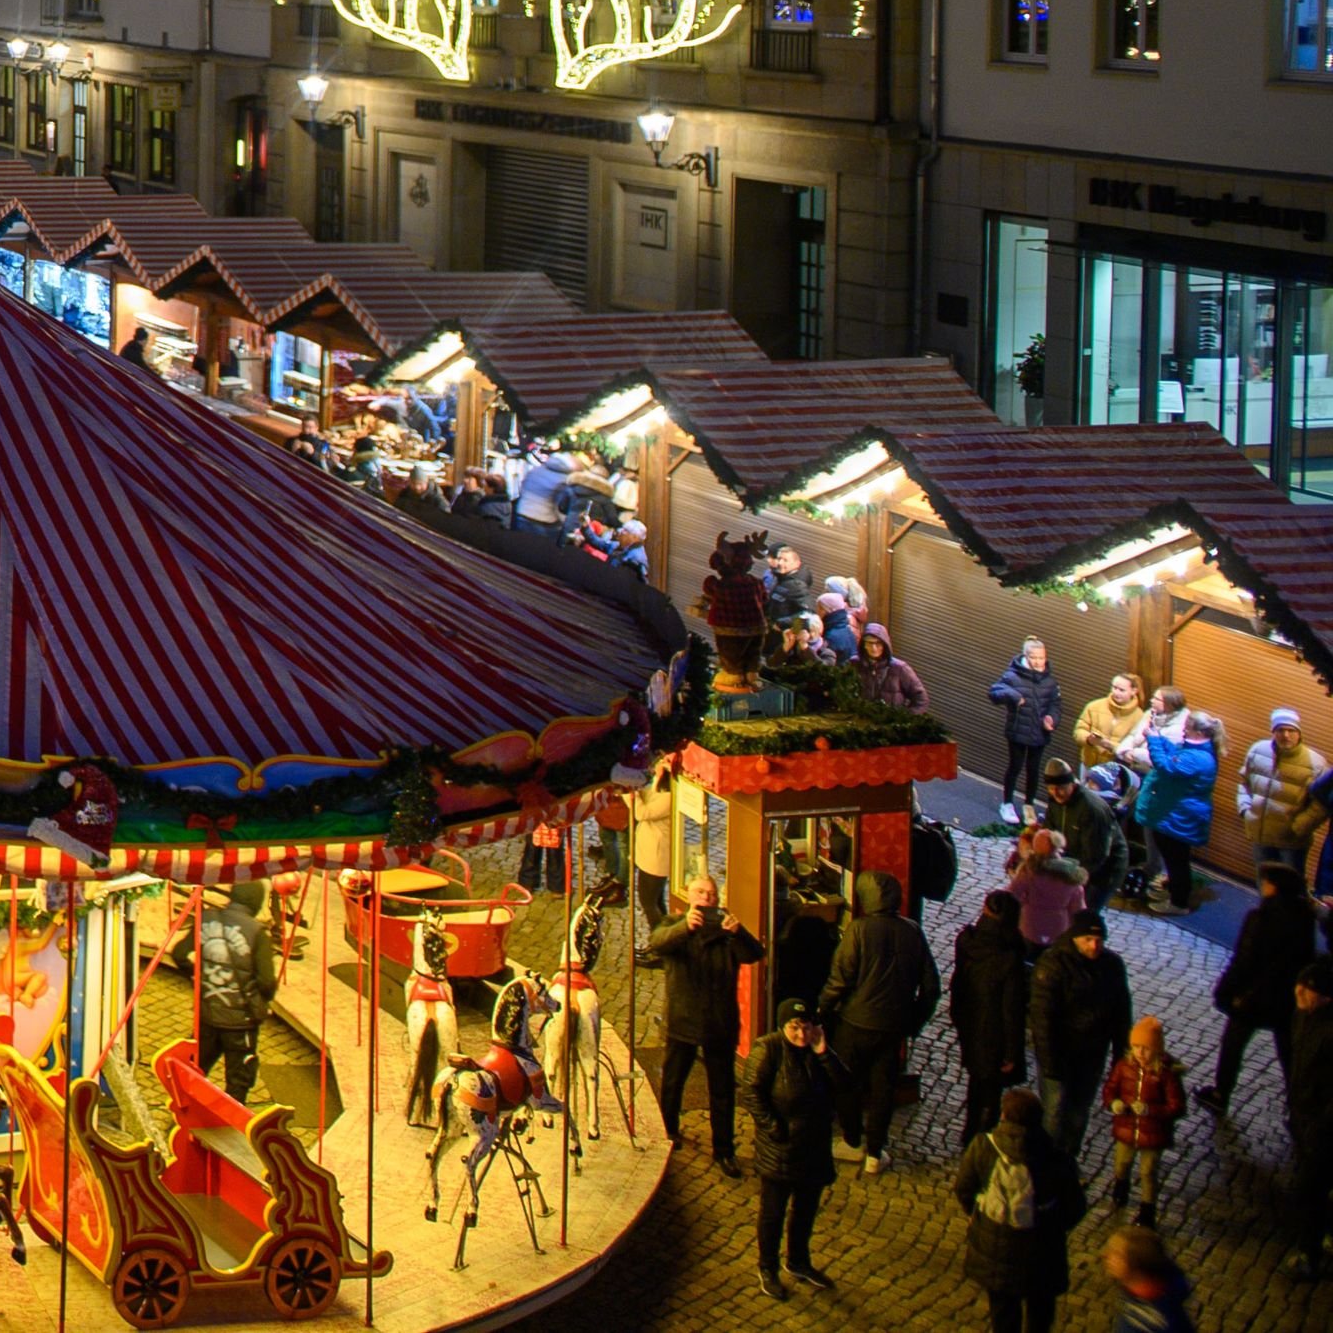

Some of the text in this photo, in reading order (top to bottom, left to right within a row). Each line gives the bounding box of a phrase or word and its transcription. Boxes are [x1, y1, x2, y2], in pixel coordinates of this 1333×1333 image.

[415, 99, 443, 122] IHK
[640, 211, 664, 230] IHK
[1090, 177, 1326, 242] IHK Magdeburg
